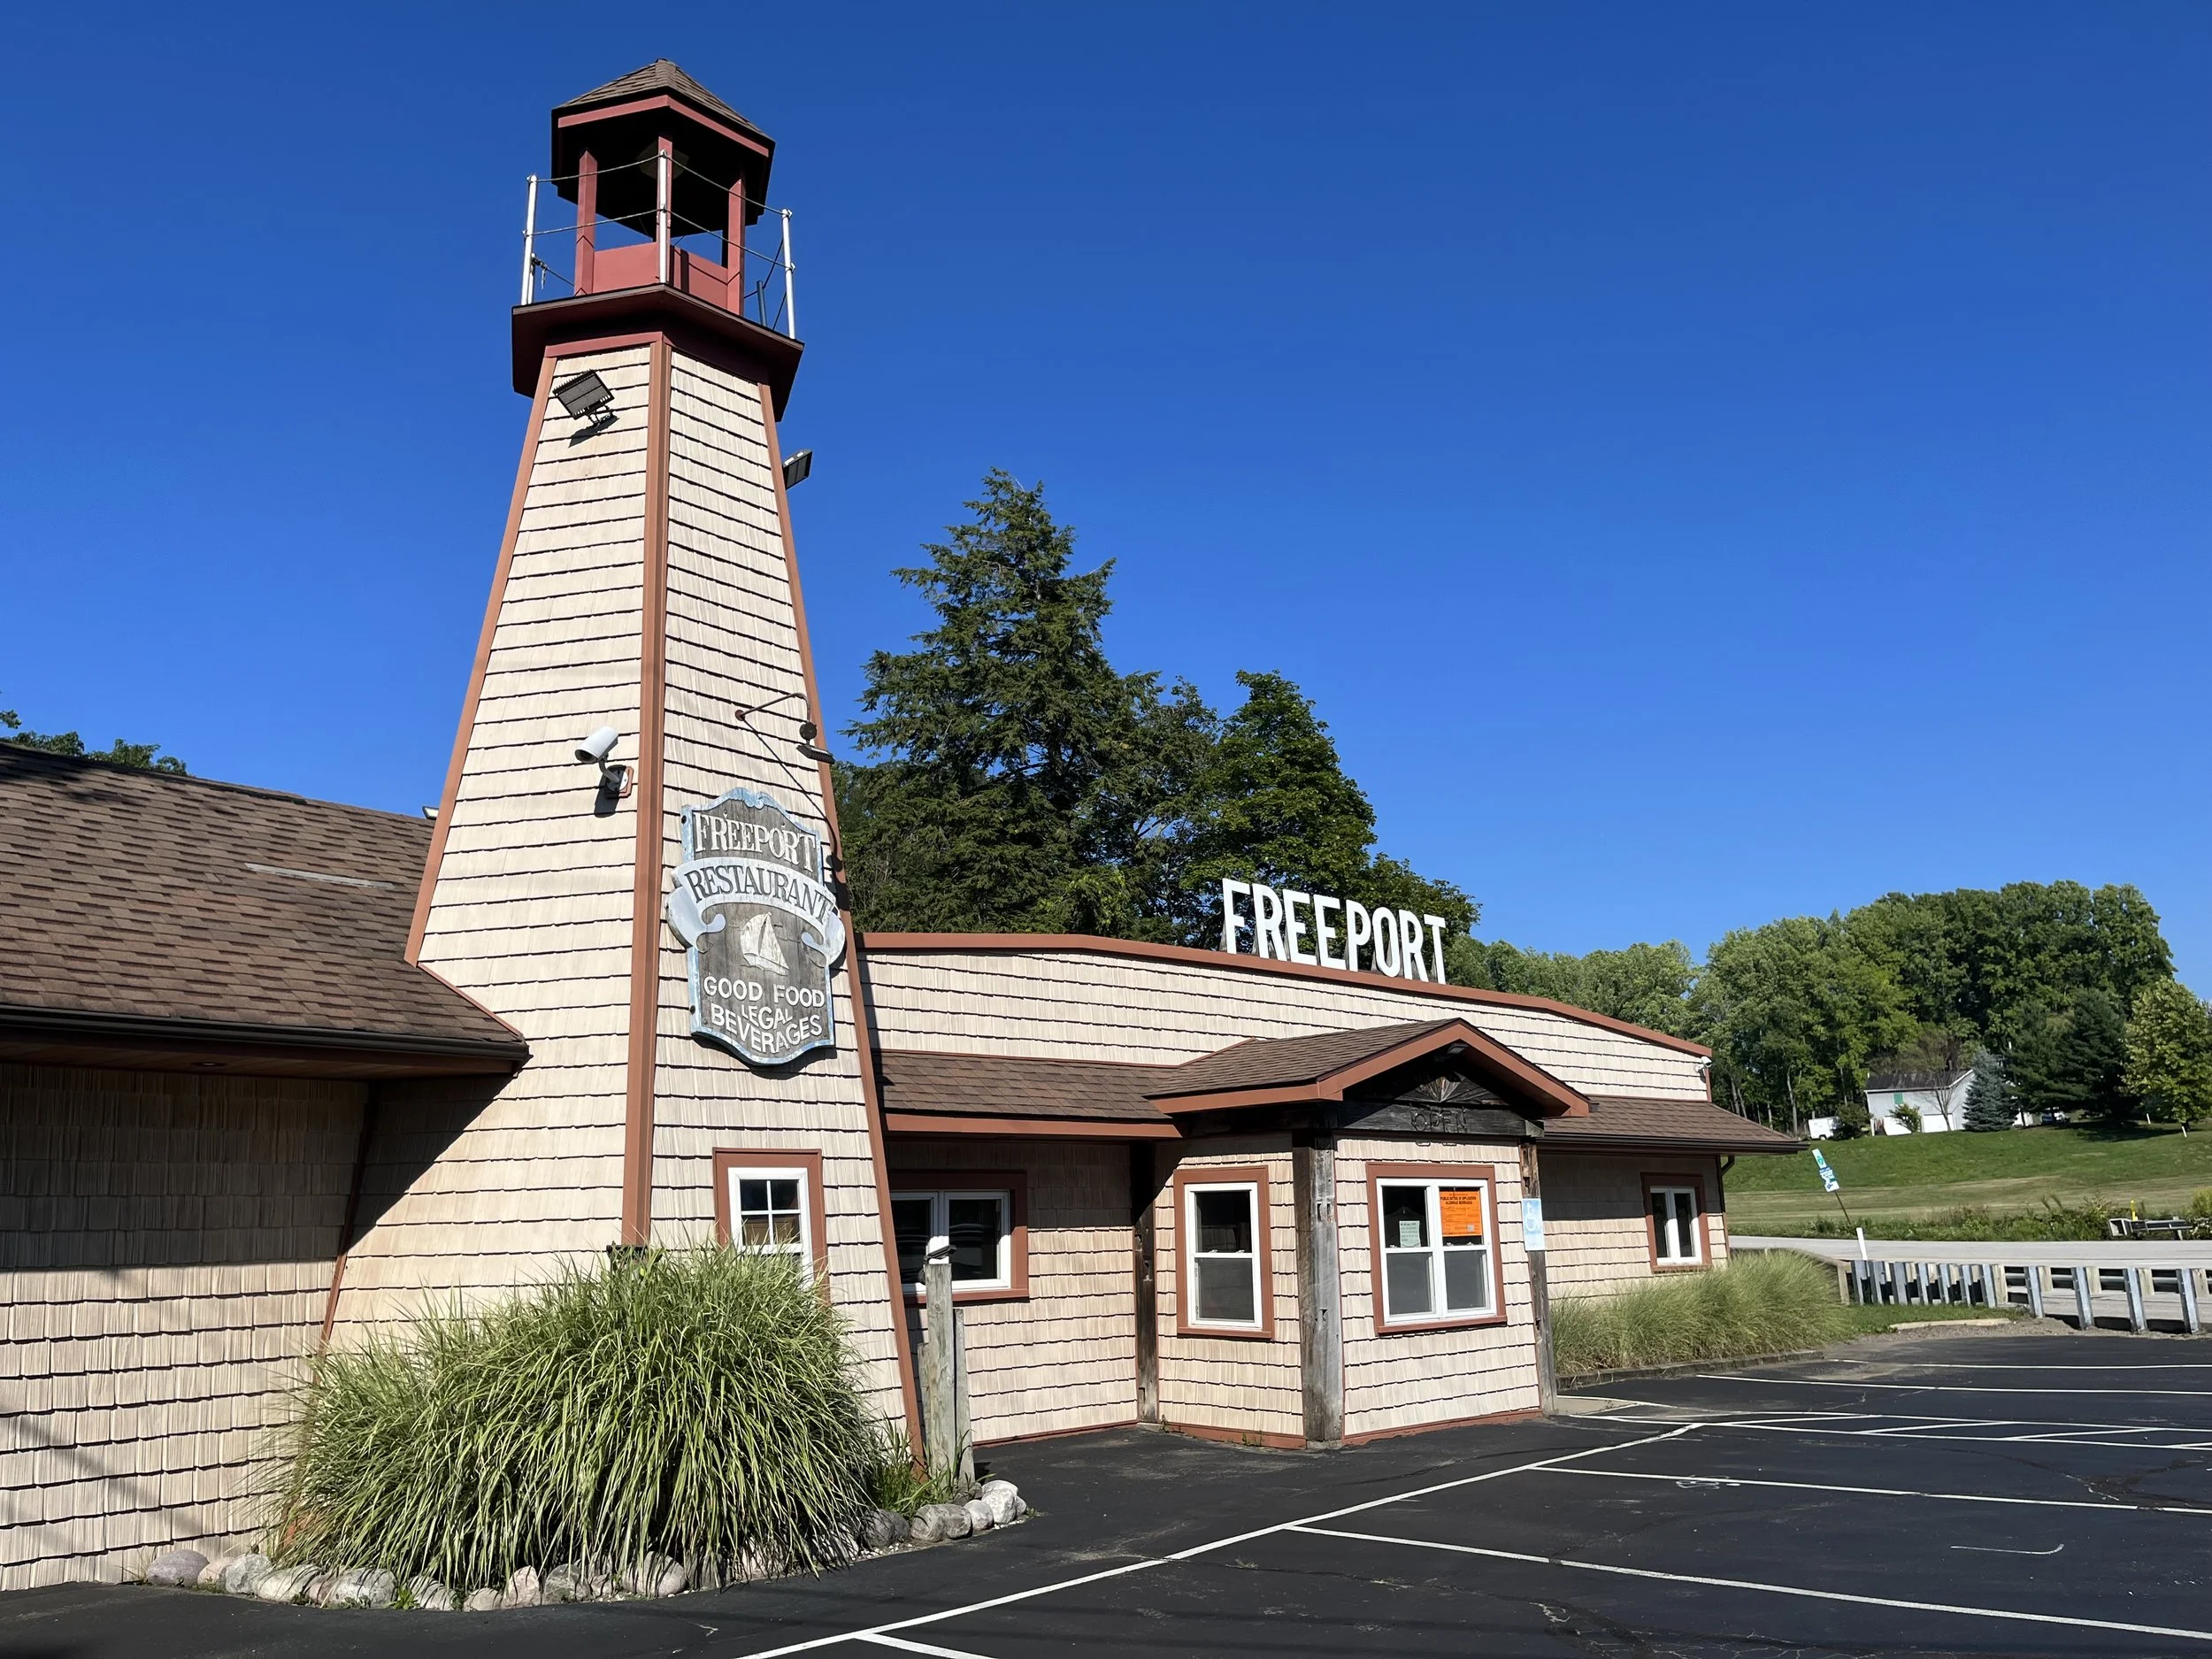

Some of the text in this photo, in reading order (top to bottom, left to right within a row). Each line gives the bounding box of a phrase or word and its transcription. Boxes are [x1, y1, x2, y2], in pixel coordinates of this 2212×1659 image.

[694, 812, 815, 872] FREEPORT
[685, 864, 834, 925] RESTAURANT
[1222, 878, 1447, 985] FREEPORT
[703, 976, 825, 1008] GOOD FOOD
[741, 1003, 793, 1030] LEGAL
[711, 1004, 822, 1054] BEVERAGES
